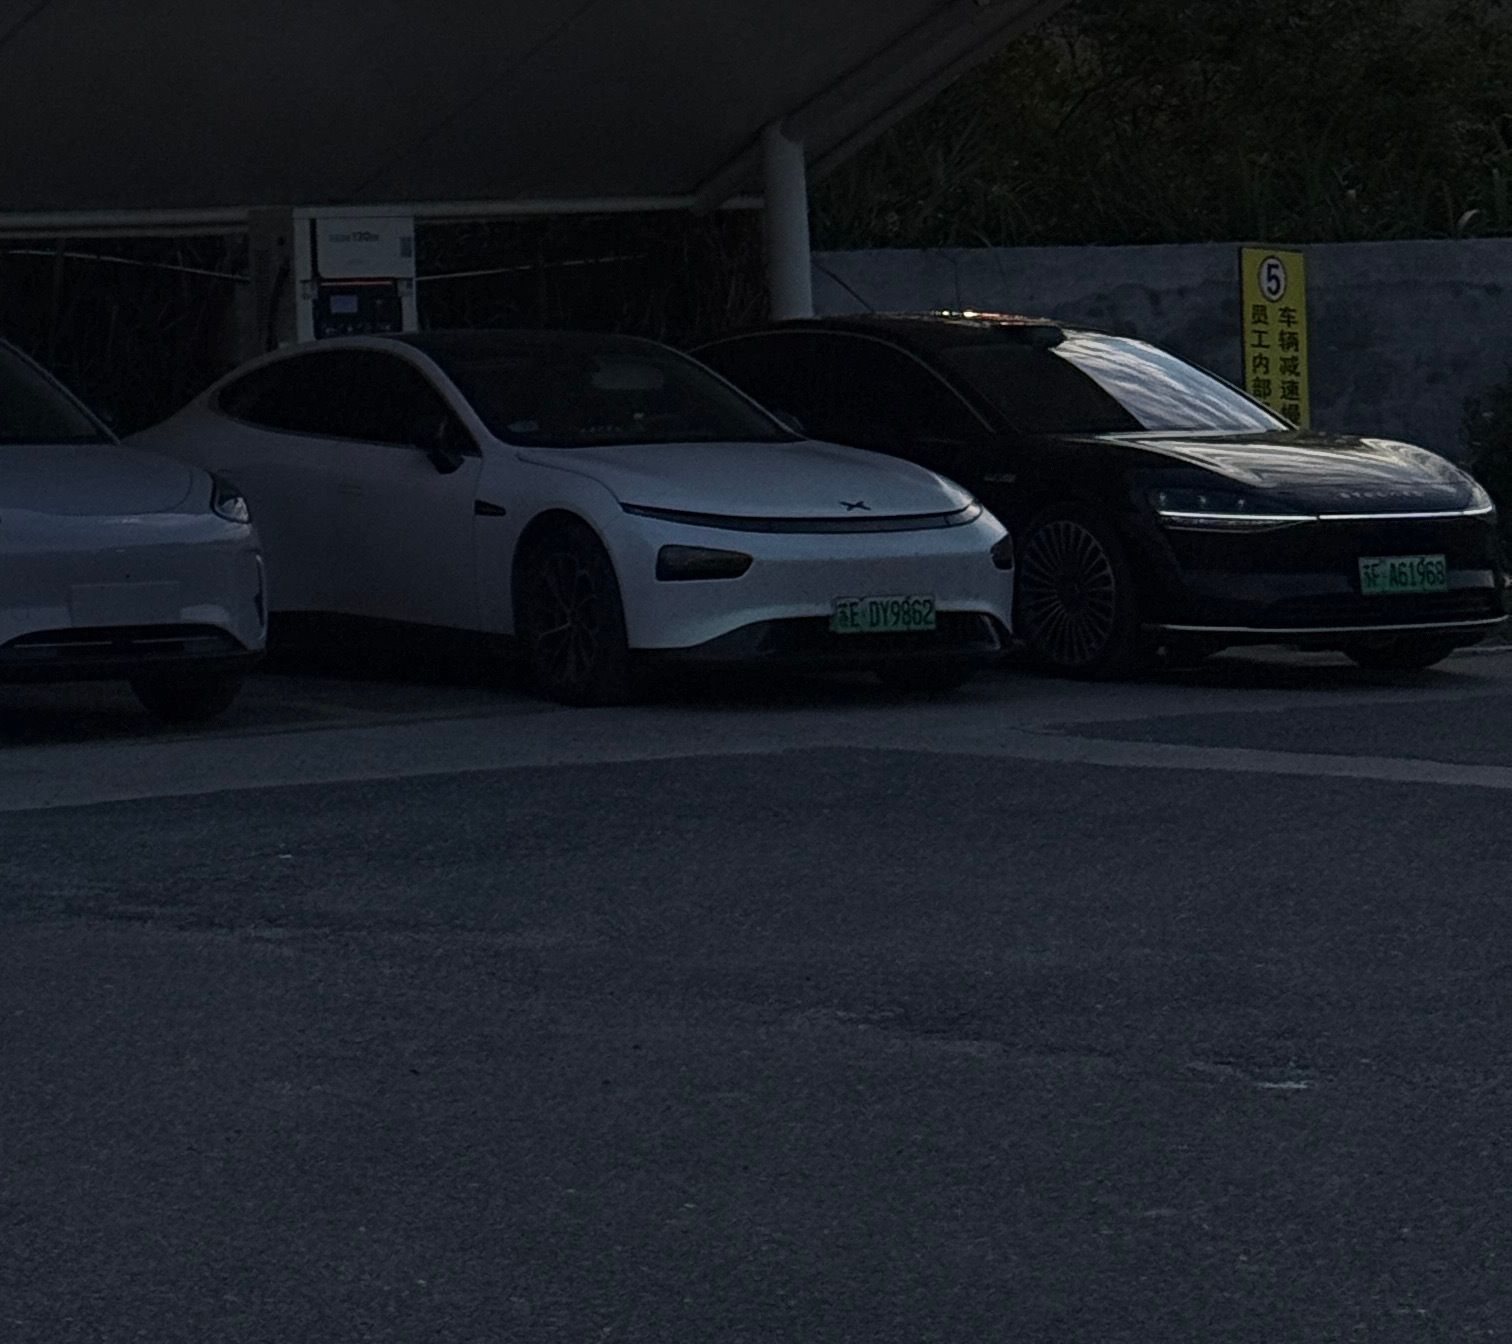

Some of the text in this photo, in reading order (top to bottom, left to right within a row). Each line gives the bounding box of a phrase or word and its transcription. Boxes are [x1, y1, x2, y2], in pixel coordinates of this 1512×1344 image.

[1266, 263, 1281, 296] 5
[1251, 304, 1272, 411] 员工内部
